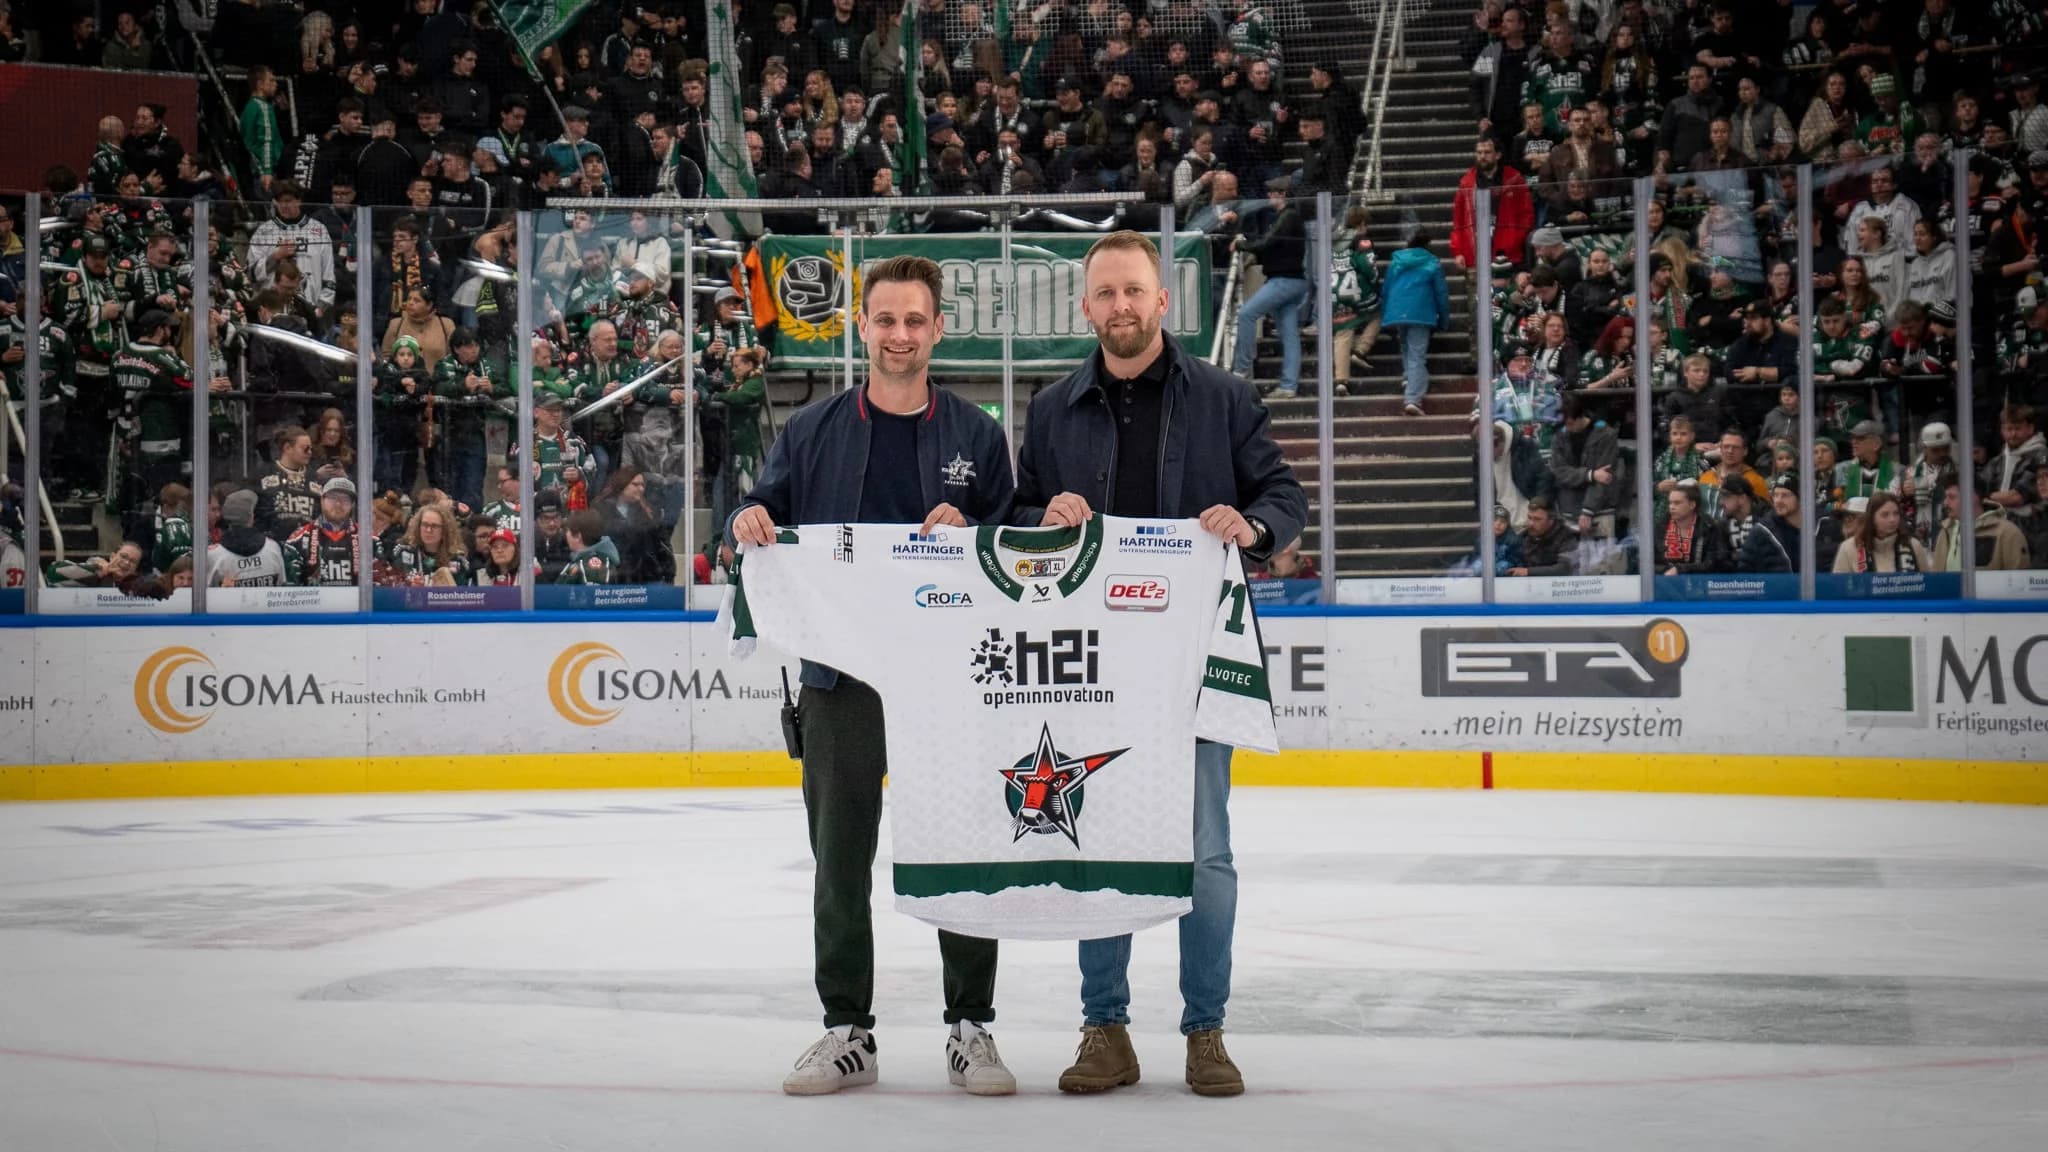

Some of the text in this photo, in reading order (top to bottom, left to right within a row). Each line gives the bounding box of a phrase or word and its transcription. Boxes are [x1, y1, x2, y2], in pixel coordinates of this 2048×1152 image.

[1119, 537, 1192, 549] HARTINGER
[892, 544, 964, 555] HARTINGER
[1118, 548, 1192, 556] UNTERNEHMENSGRUPPE
[1053, 562, 1062, 571] XL
[1390, 583, 1446, 593] Rosenheimer
[1707, 580, 1765, 589] Rosenheimer
[427, 591, 486, 600] Rosenheimer
[611, 586, 647, 597] regionale
[594, 595, 648, 606] Betriebsrente!
[927, 593, 973, 604] ROFA
[1016, 629, 1099, 685] h2i
[1447, 643, 1655, 682] ETA
[184, 673, 485, 707] ISOMA Haustechnik GmbH
[598, 668, 732, 701] ISOMA
[983, 687, 1114, 709] openinnovation
[1535, 711, 1683, 742] Heizsystem
[44, 799, 803, 835] KRONE
